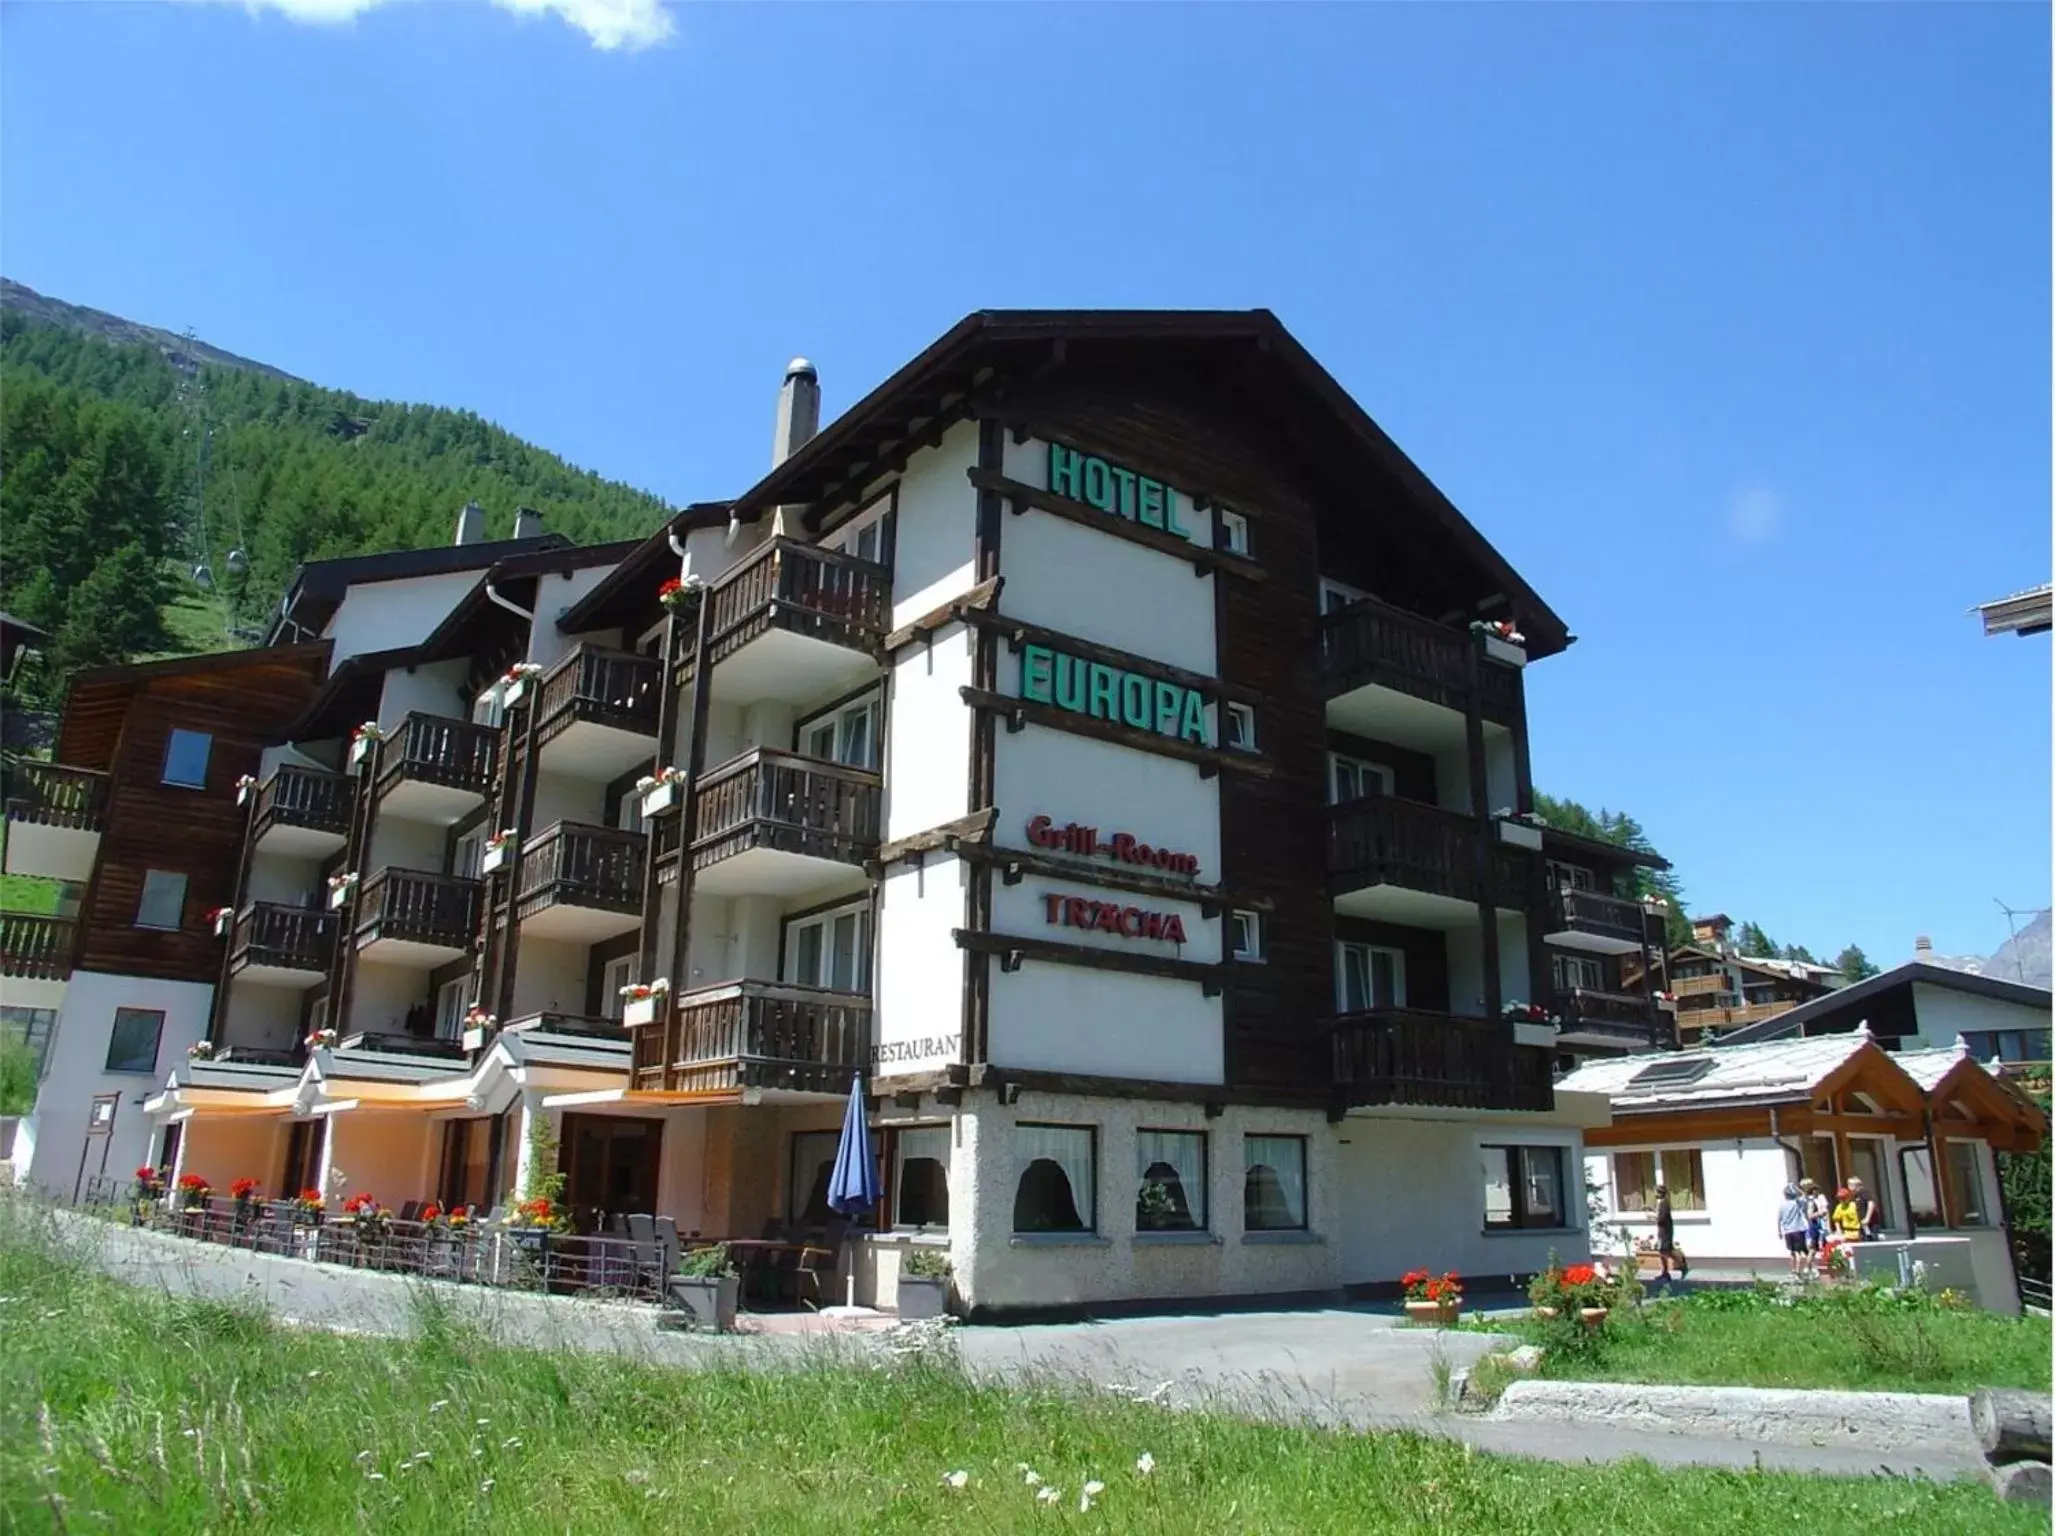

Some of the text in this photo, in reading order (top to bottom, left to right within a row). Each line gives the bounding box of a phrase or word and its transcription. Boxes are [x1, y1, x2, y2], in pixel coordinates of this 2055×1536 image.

[1049, 442, 1190, 539] HOTEL
[1021, 643, 1207, 744] EUROPA
[1027, 814, 1200, 875] Grill-Room
